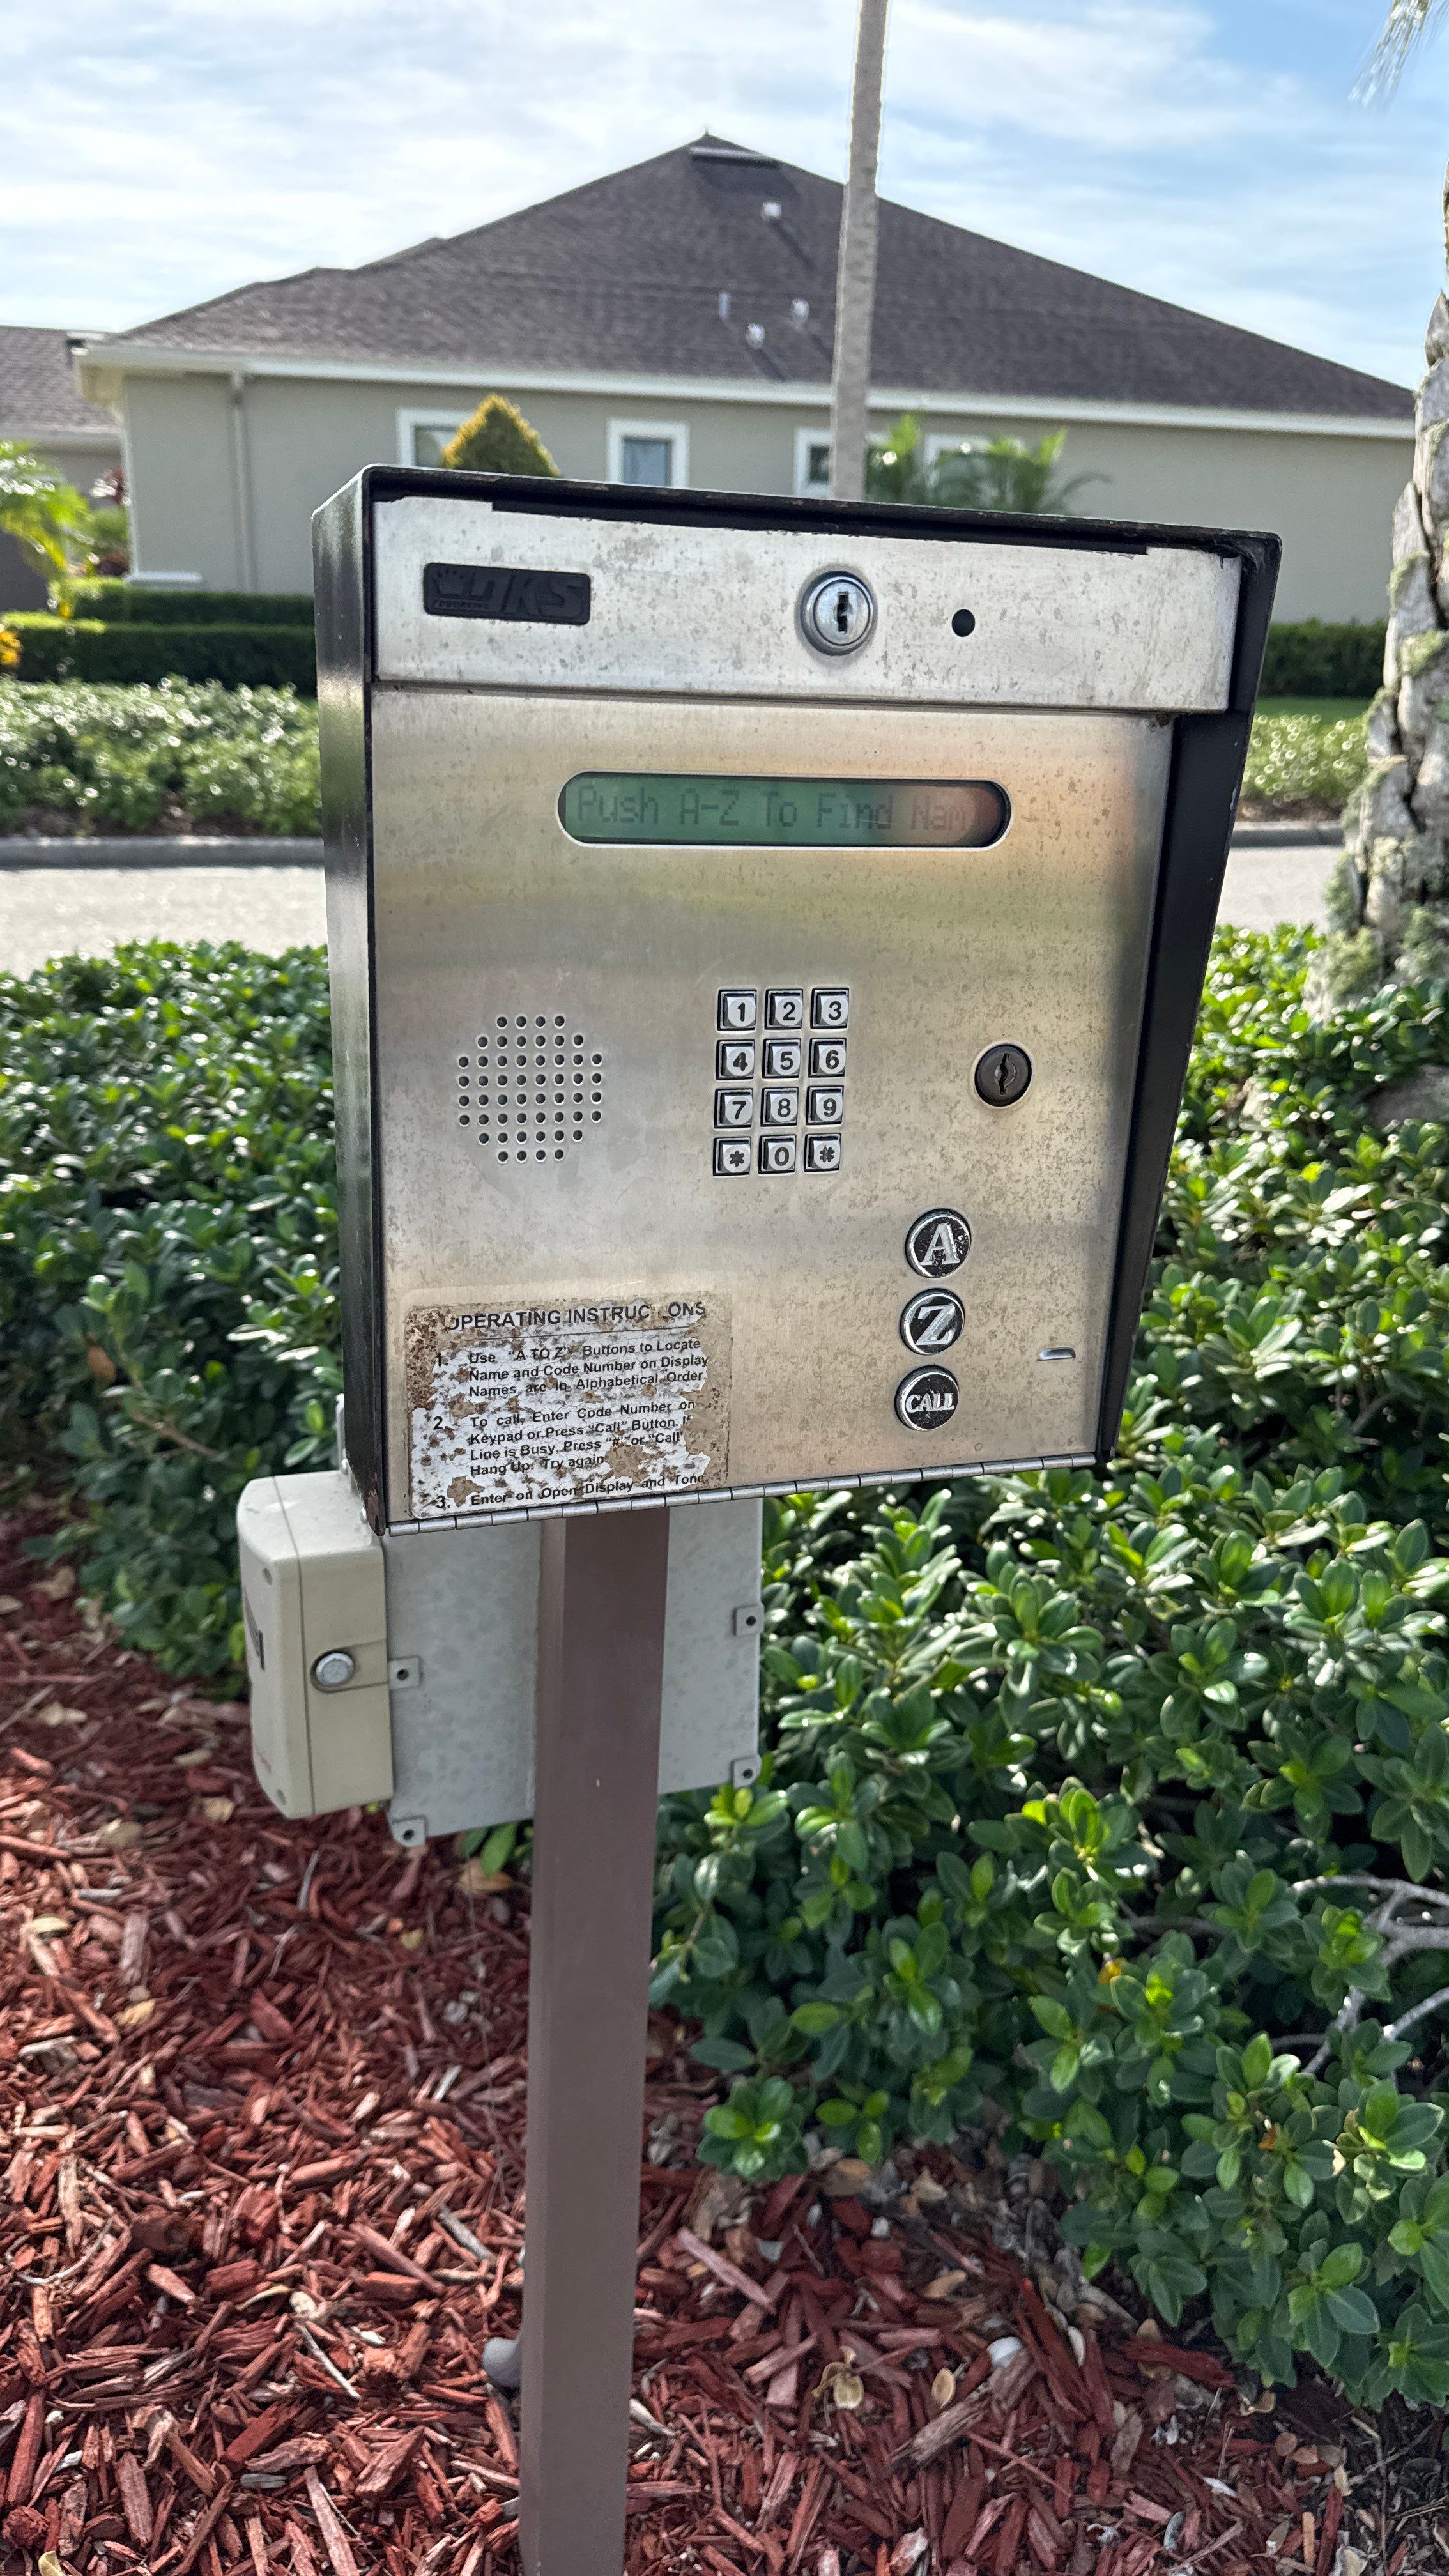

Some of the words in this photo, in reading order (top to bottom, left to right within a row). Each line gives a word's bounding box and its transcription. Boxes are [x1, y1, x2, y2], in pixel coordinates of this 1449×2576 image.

[578, 783, 659, 825] Push
[679, 788, 740, 827] A-Z
[763, 790, 797, 827] To
[816, 791, 893, 830] Find
[737, 1002, 746, 1022] 1
[782, 1000, 796, 1021] 2
[827, 1000, 842, 1021] 3
[732, 1052, 748, 1071] 4
[780, 1051, 793, 1070] 5
[825, 1050, 839, 1070] 6
[732, 1100, 746, 1120] 7
[776, 1098, 792, 1117] 8
[822, 1098, 837, 1117] 9
[774, 1147, 790, 1166] 0
[819, 1144, 835, 1163] #
[919, 1222, 961, 1266] A
[448, 1310, 561, 1330] OPERATING
[568, 1301, 706, 1324] INSTRUCONS
[916, 1303, 956, 1346] Z
[468, 1351, 496, 1364] Use
[530, 1347, 551, 1360] TO
[583, 1343, 635, 1356] Buttons
[640, 1342, 653, 1353] to
[657, 1338, 701, 1351] Locate
[470, 1369, 509, 1381] Name
[513, 1366, 539, 1378] and
[544, 1364, 579, 1376] Code
[583, 1360, 636, 1373] Number
[641, 1360, 657, 1369] on
[661, 1355, 709, 1369] Display
[470, 1384, 518, 1397] Names
[525, 1383, 547, 1393] are
[555, 1381, 567, 1392] in
[576, 1373, 659, 1390] Alphabetical
[666, 1371, 703, 1383] Order
[470, 1416, 488, 1428] To
[496, 1413, 525, 1426] call,
[533, 1411, 570, 1422] Enter
[577, 1407, 612, 1418] Code
[620, 1402, 672, 1415] Number
[678, 1401, 695, 1410] on
[906, 1390, 955, 1413] CALL
[470, 1429, 523, 1445] Keypad
[527, 1430, 542, 1439] or
[546, 1426, 584, 1438] Press
[632, 1418, 678, 1430] Button.
[471, 1449, 501, 1460] Line
[505, 1446, 516, 1457] is
[521, 1445, 559, 1457] Busy,
[564, 1441, 601, 1452] Press
[631, 1436, 645, 1446] or
[471, 1464, 507, 1477] Hang
[543, 1457, 564, 1470] Try
[436, 1495, 450, 1509] 3.
[471, 1493, 508, 1506] Enter
[516, 1491, 533, 1500] on
[541, 1487, 577, 1499] Open
[585, 1480, 634, 1494] Display
[641, 1476, 665, 1488] and
